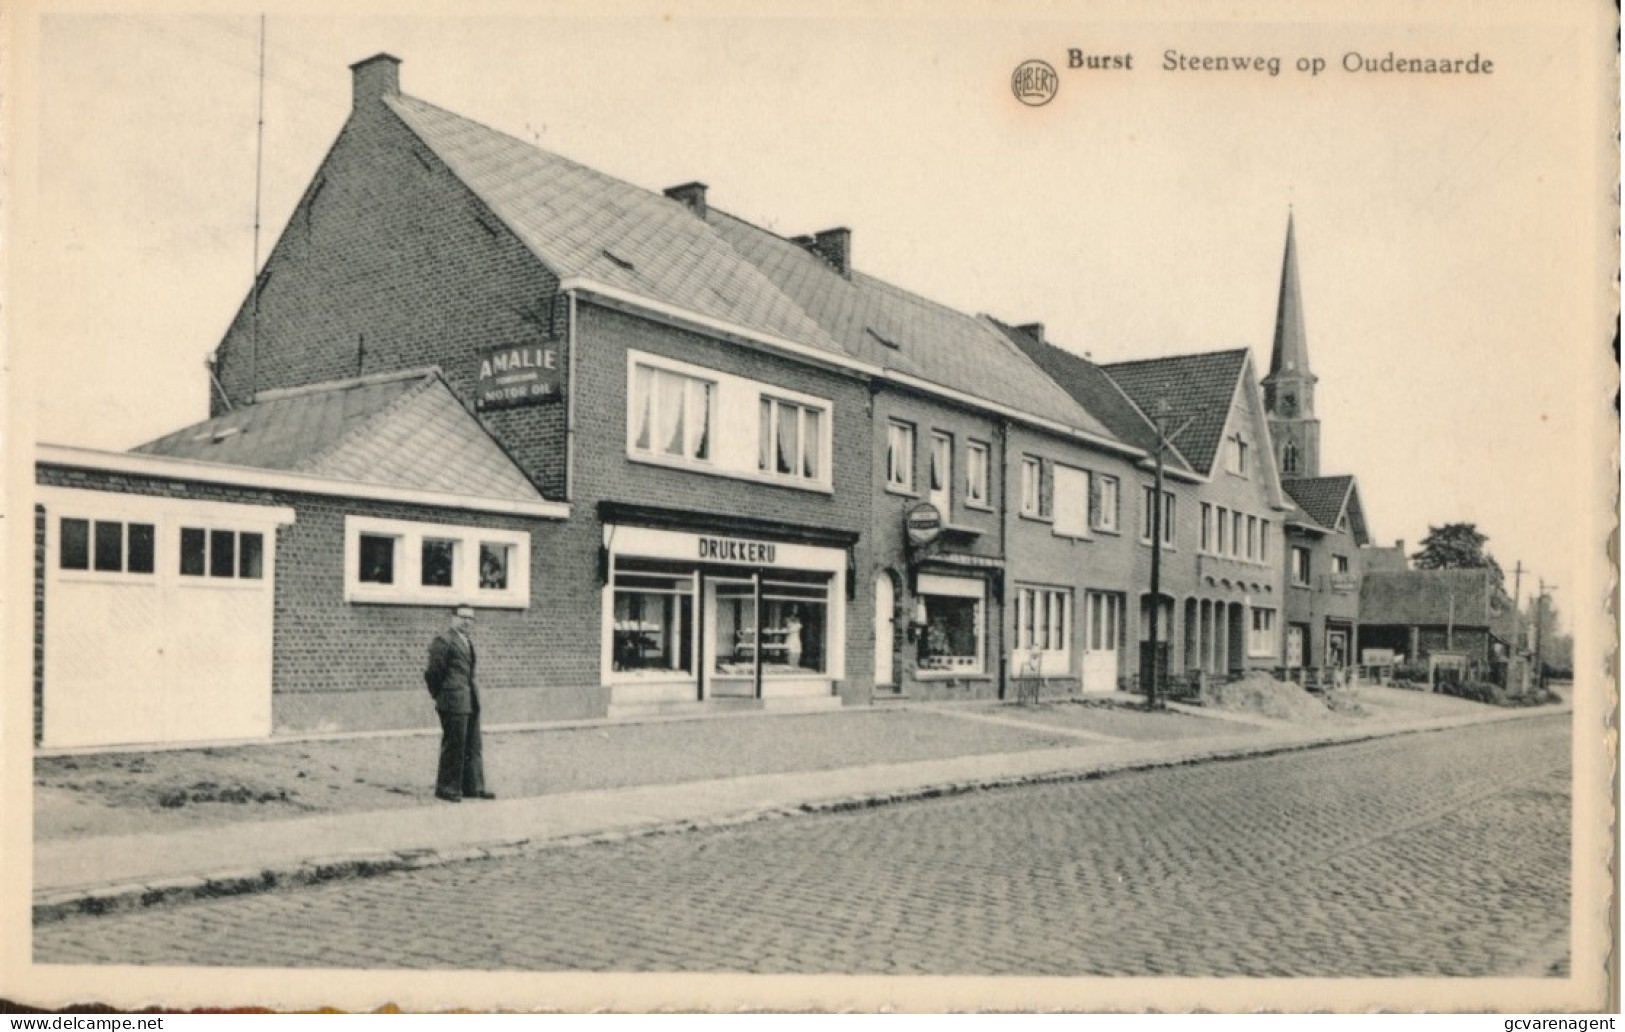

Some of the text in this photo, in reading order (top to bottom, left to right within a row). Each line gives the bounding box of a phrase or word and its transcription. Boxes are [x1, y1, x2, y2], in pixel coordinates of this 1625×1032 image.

[480, 349, 557, 380] AMALIE
[485, 383, 552, 401] MOTOR OIL
